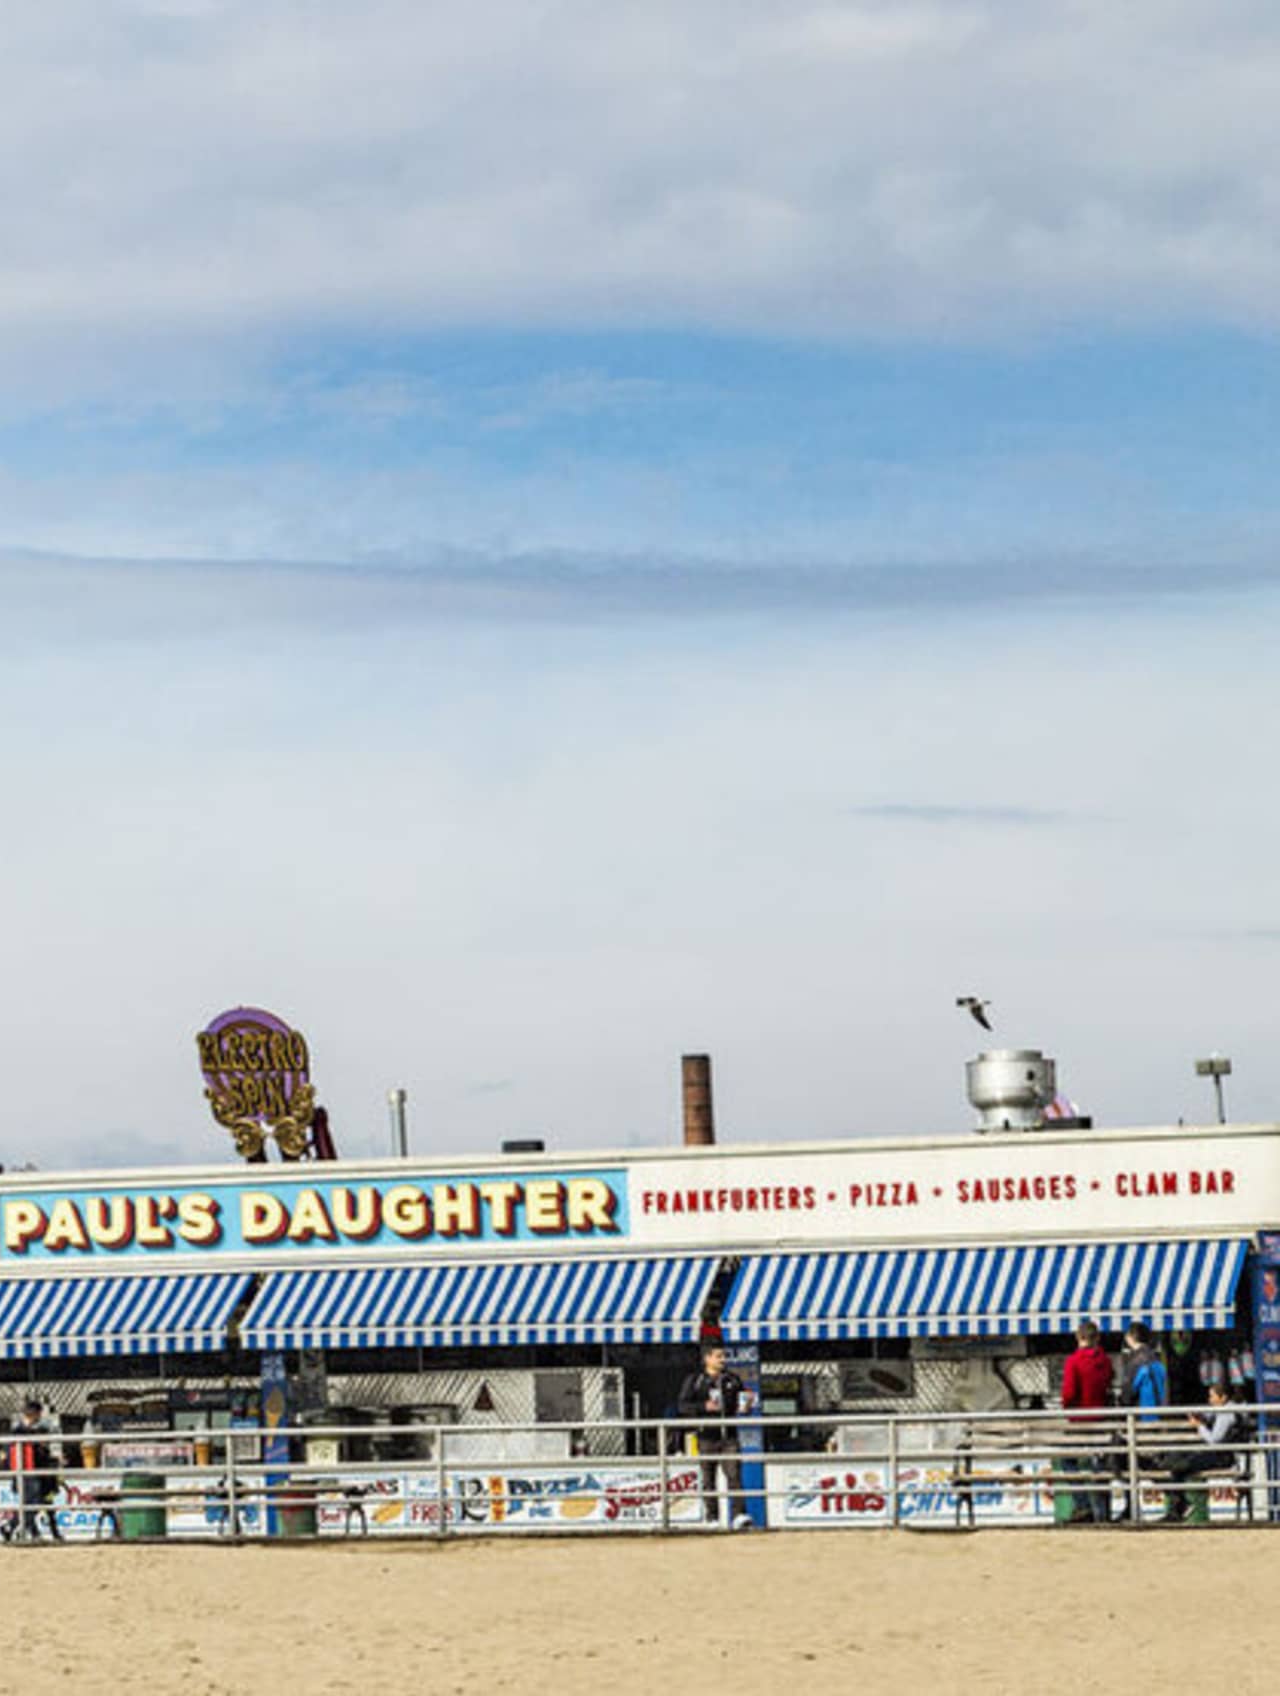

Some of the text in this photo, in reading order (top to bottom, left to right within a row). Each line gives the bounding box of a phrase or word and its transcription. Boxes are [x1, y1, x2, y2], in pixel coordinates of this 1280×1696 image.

[3, 1179, 621, 1253] PAUL'S DAUGHTER
[643, 1170, 1234, 1212] FRANKFURTERS PIZZA SAUSAGES CLAM BAR
